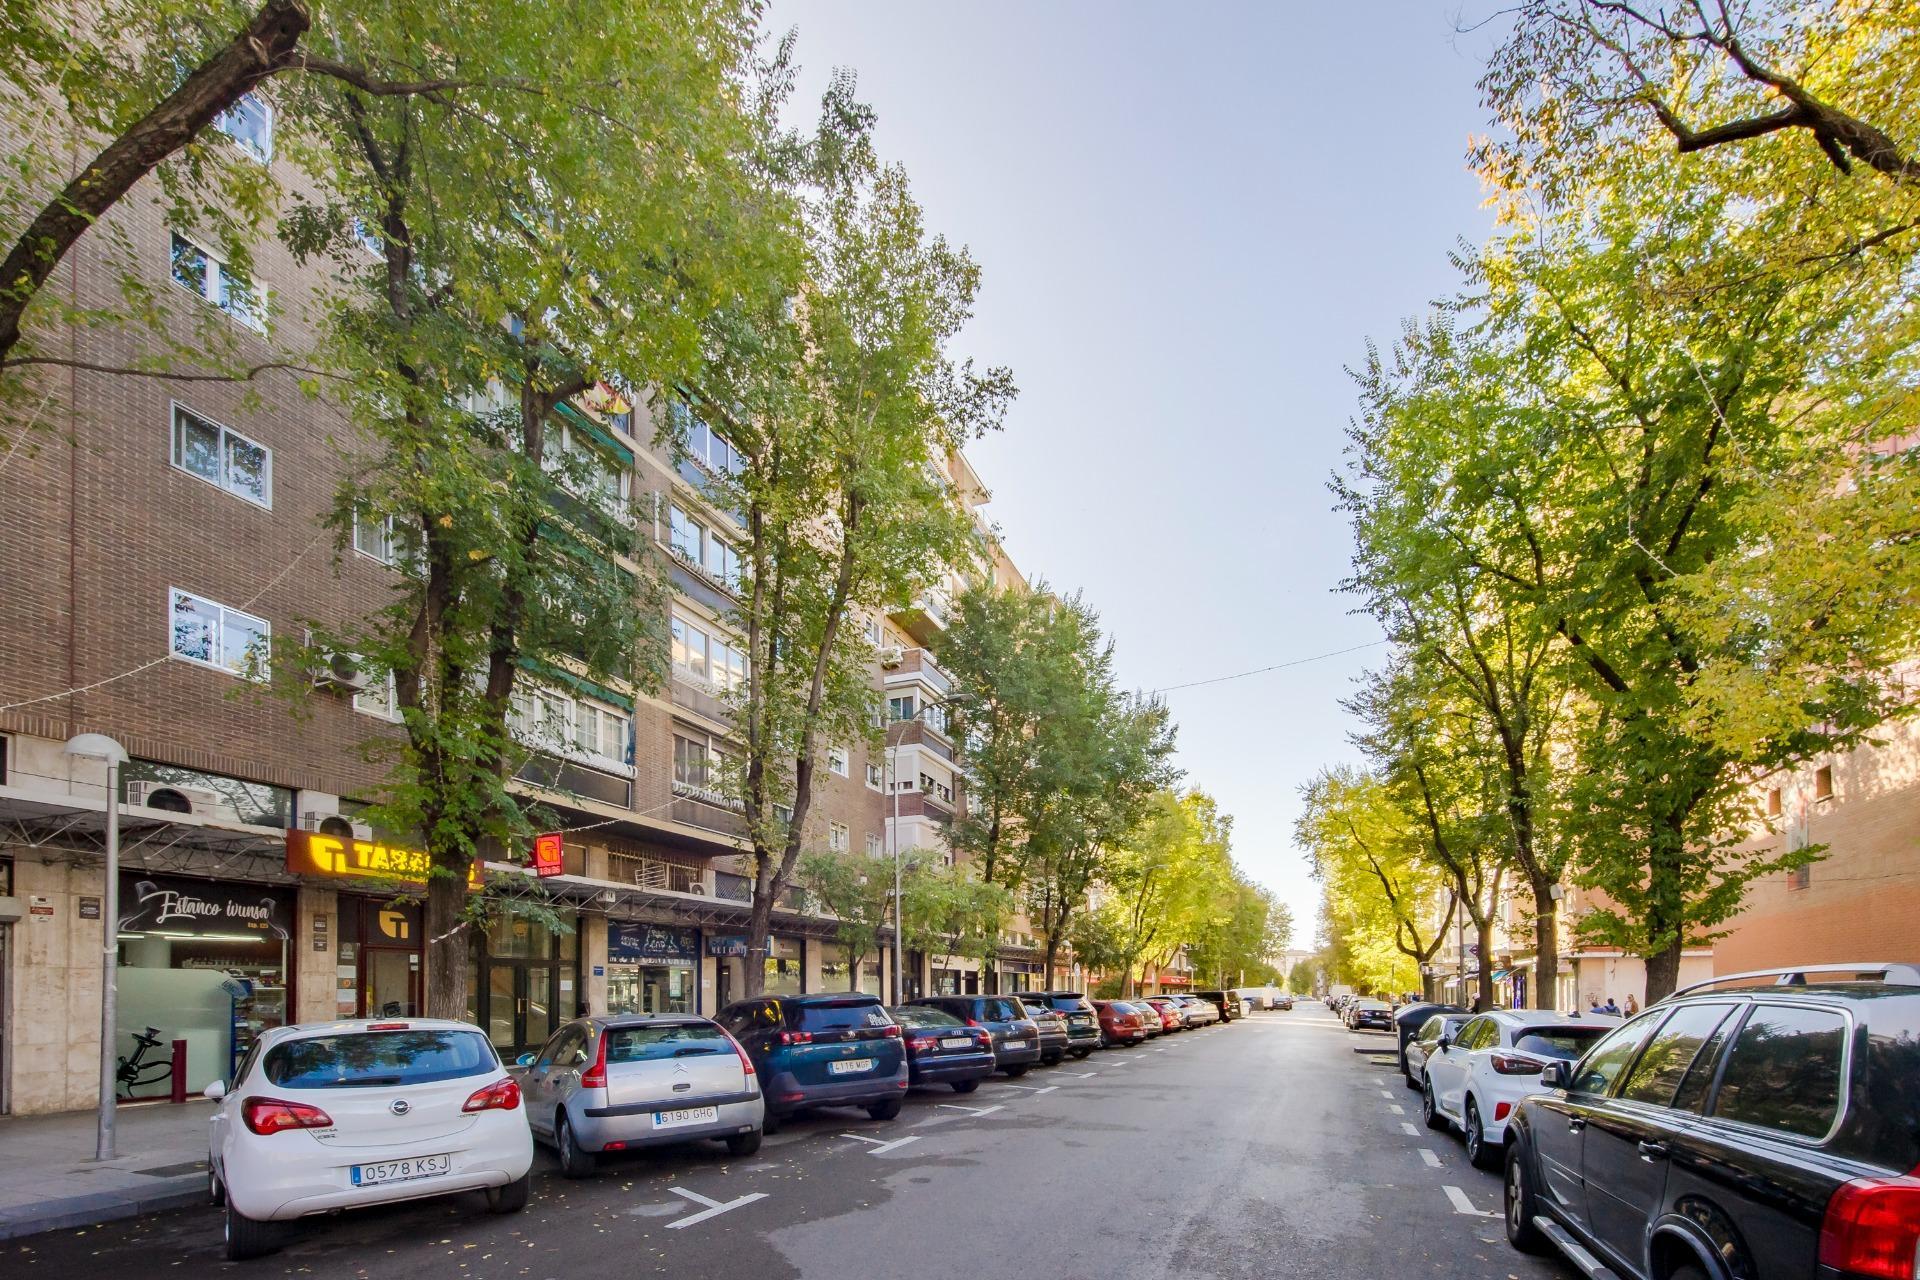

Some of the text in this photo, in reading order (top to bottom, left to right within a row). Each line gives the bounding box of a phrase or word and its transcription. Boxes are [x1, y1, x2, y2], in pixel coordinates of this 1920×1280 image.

[139, 890, 222, 924] Estanco
[661, 1108, 713, 1123] 6190 GHG
[365, 1156, 449, 1180] 0578 KSJ
